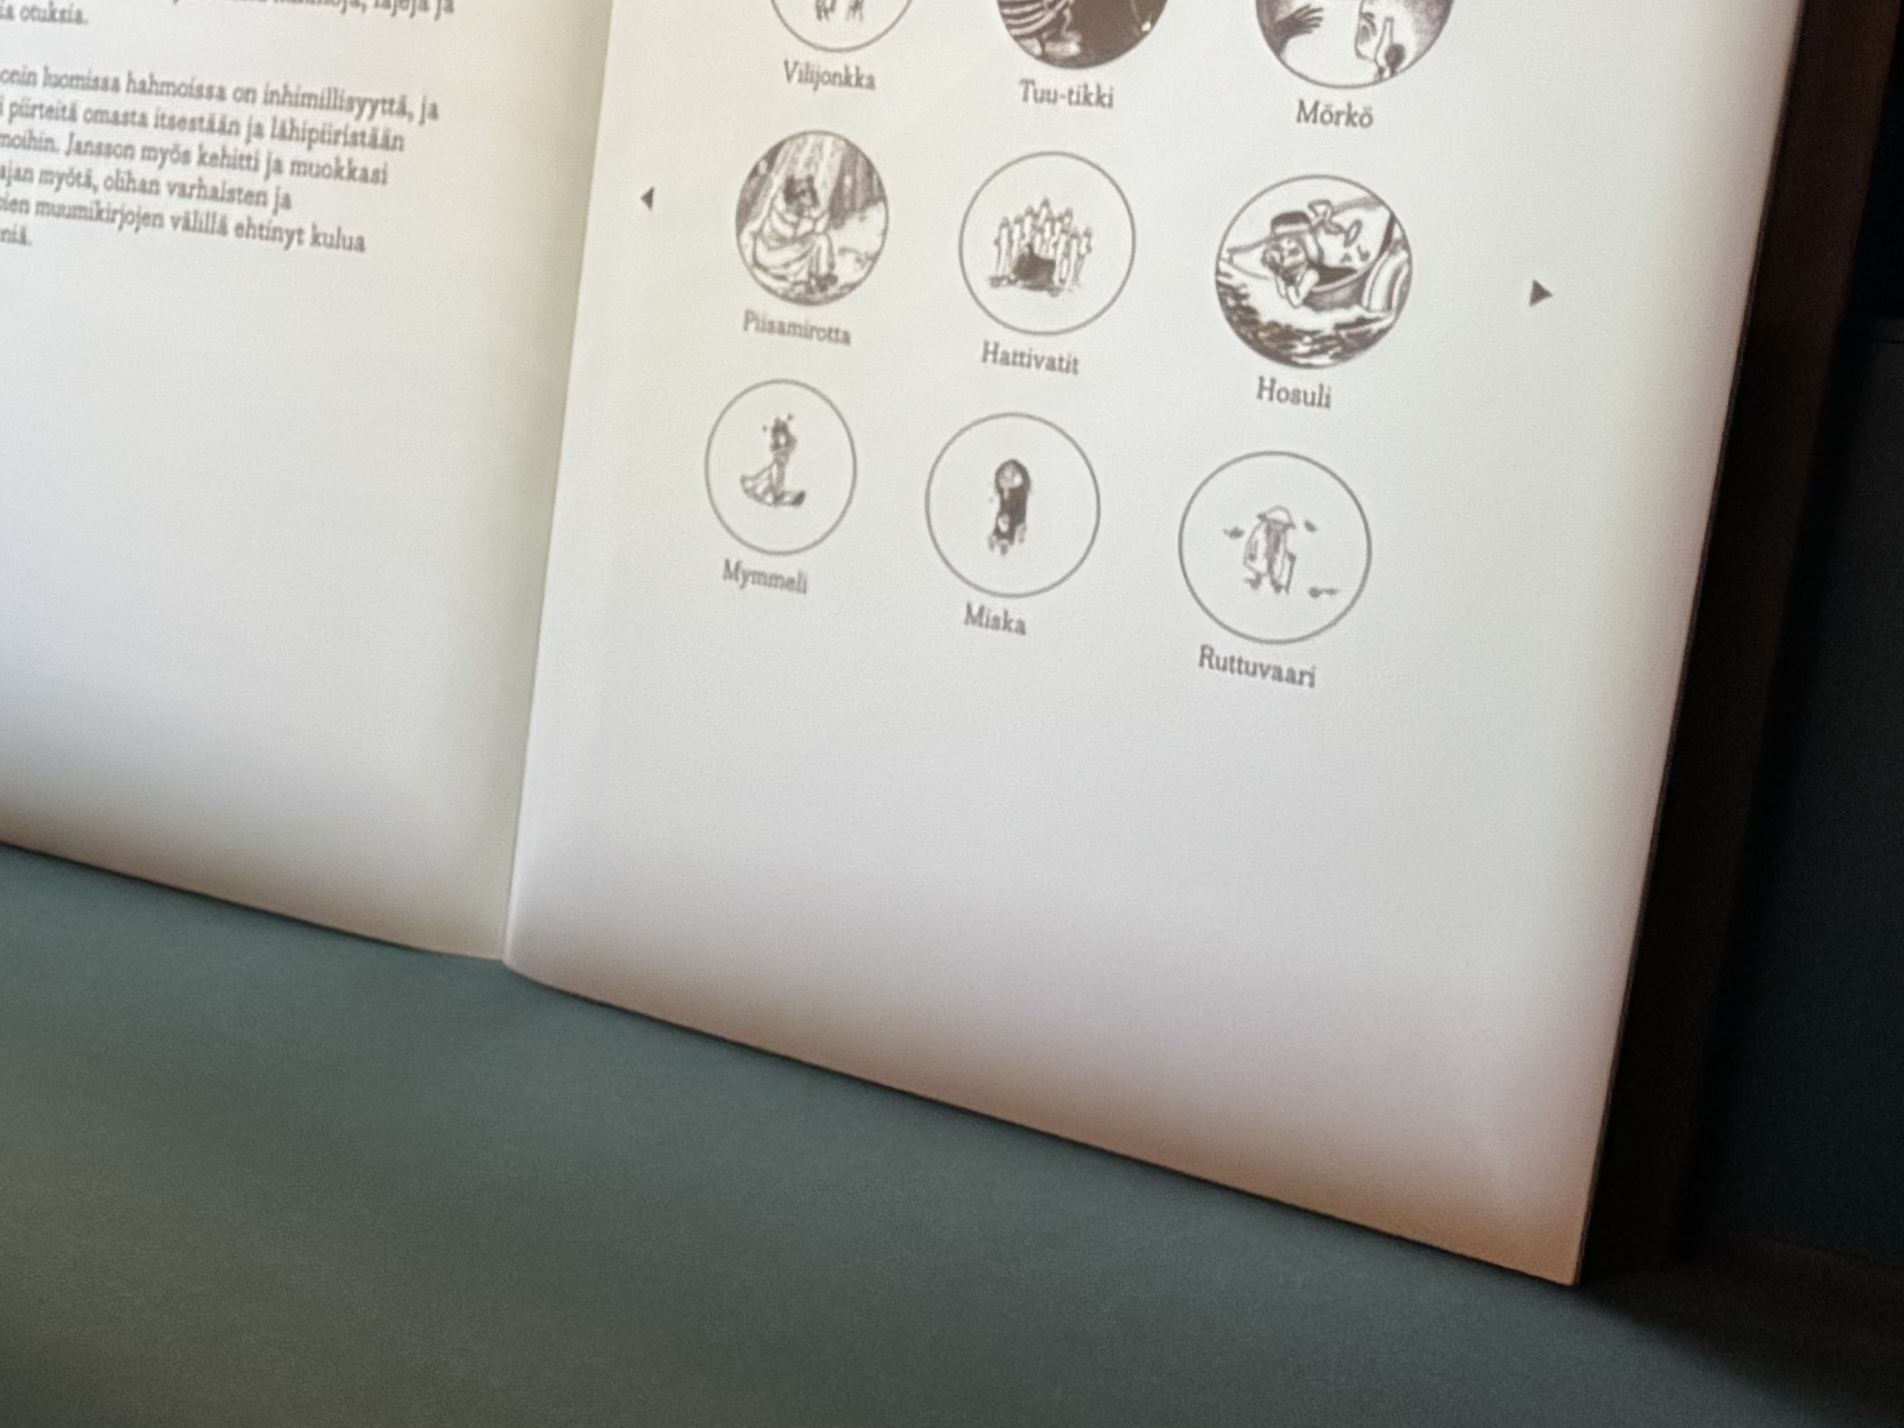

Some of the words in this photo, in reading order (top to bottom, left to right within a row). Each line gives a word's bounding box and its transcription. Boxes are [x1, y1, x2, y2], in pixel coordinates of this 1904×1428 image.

[20, 0, 89, 25] otuksia.
[782, 60, 877, 92] Vilijonkka
[42, 65, 121, 93] luomissa
[125, 71, 227, 102] hahmoissa
[232, 85, 257, 105] on
[262, 82, 414, 122] inhimillisyyttä,
[418, 95, 439, 126] ja
[1018, 79, 1115, 110] Tuu-tikki
[8, 97, 77, 124] piirteitä
[83, 107, 148, 128] omasta
[154, 108, 240, 137] itsestään
[245, 116, 264, 145] ja
[271, 117, 405, 152] lähipiiristään
[1296, 100, 1374, 129] Mörkö
[65, 132, 135, 161] Jansson
[140, 143, 191, 170] myös
[197, 144, 260, 172] kehitti
[264, 151, 283, 181] ja
[289, 155, 388, 185] muokkasi
[39, 168, 98, 193] myötä,
[103, 169, 161, 196] olihan
[167, 177, 268, 207] varhaisten
[272, 185, 292, 216] ja
[35, 199, 164, 233] muumikirjojen
[170, 209, 228, 236] välillä
[234, 215, 305, 251] ehtinyt
[310, 222, 366, 253] kulua
[742, 310, 852, 347] Piisamirotta
[981, 340, 1080, 376] Hattivatit
[1255, 376, 1333, 410] Hosuli
[722, 559, 808, 595] Mymmeli
[964, 603, 1027, 636] Miska
[1199, 645, 1317, 689] Ruttuvaari
